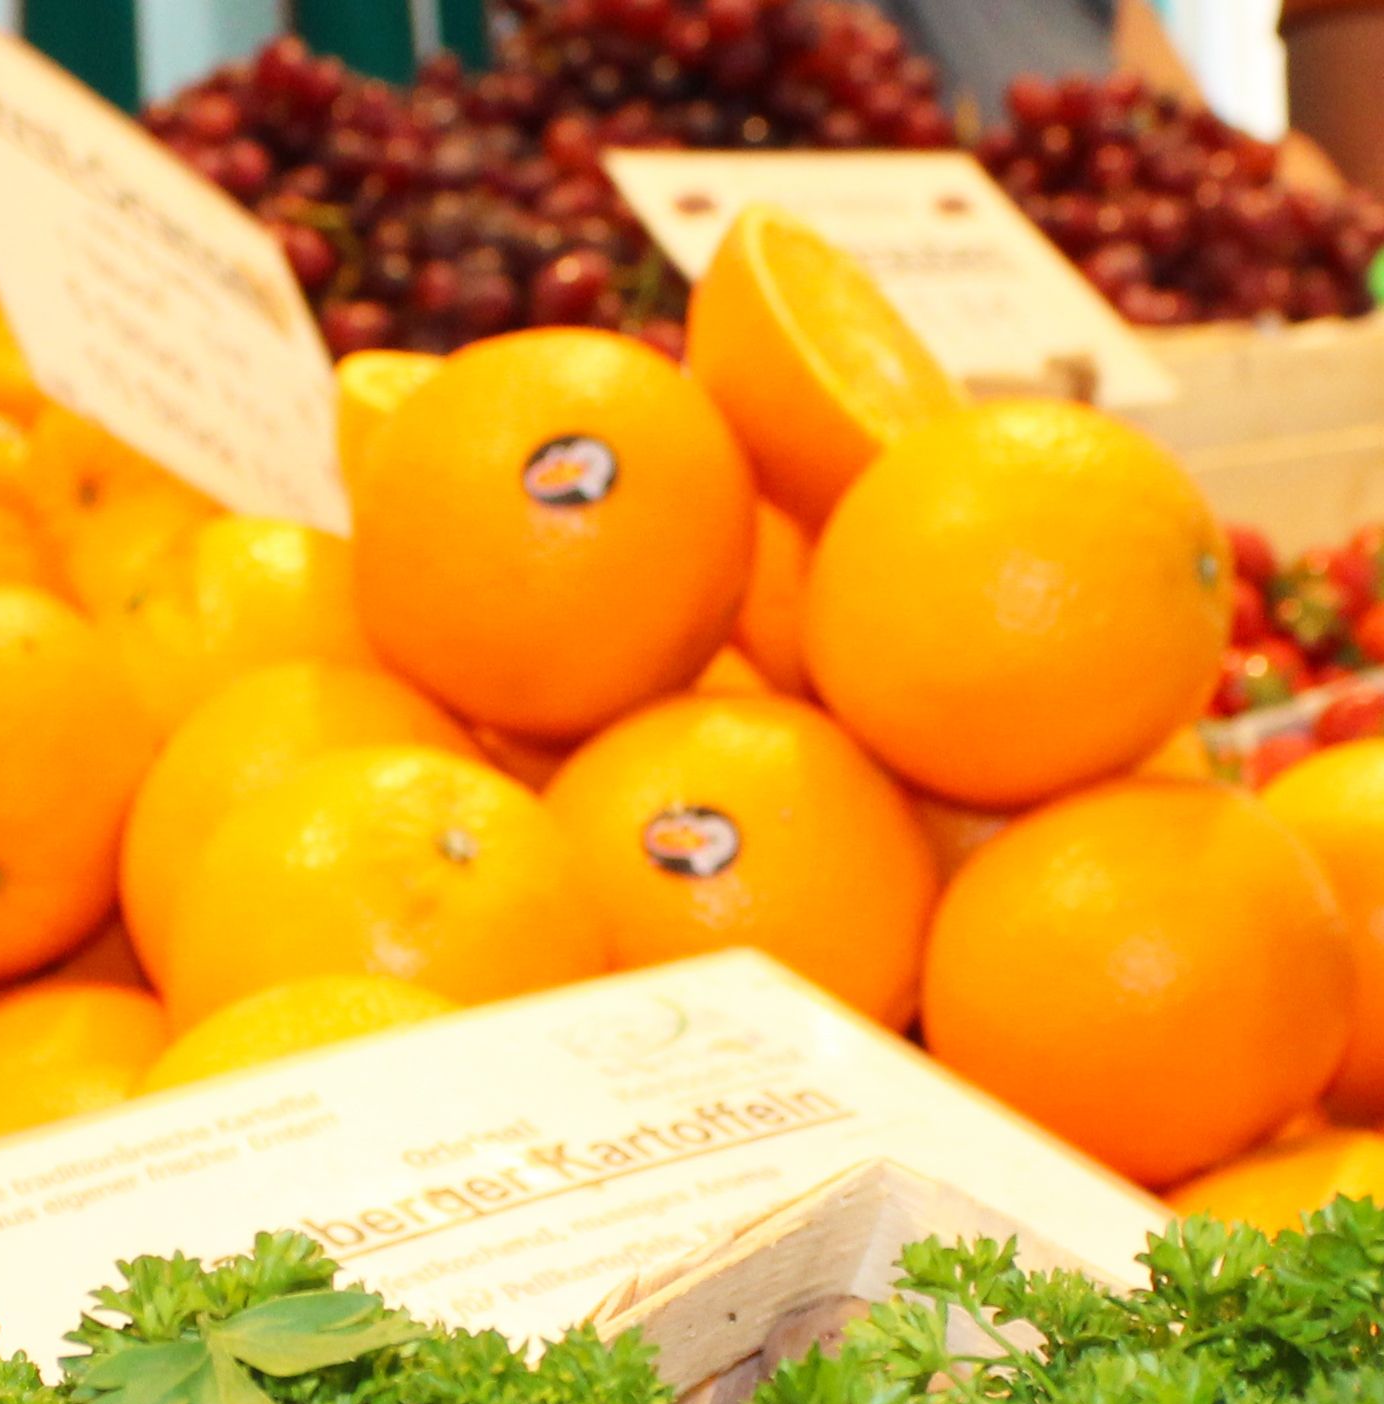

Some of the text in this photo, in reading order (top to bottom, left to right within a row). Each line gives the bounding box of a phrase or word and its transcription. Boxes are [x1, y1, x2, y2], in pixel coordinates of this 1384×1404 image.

[530, 1087, 840, 1179] Kartoffeln
[43, 1173, 139, 1217] eigener
[145, 1144, 239, 1184] frischer
